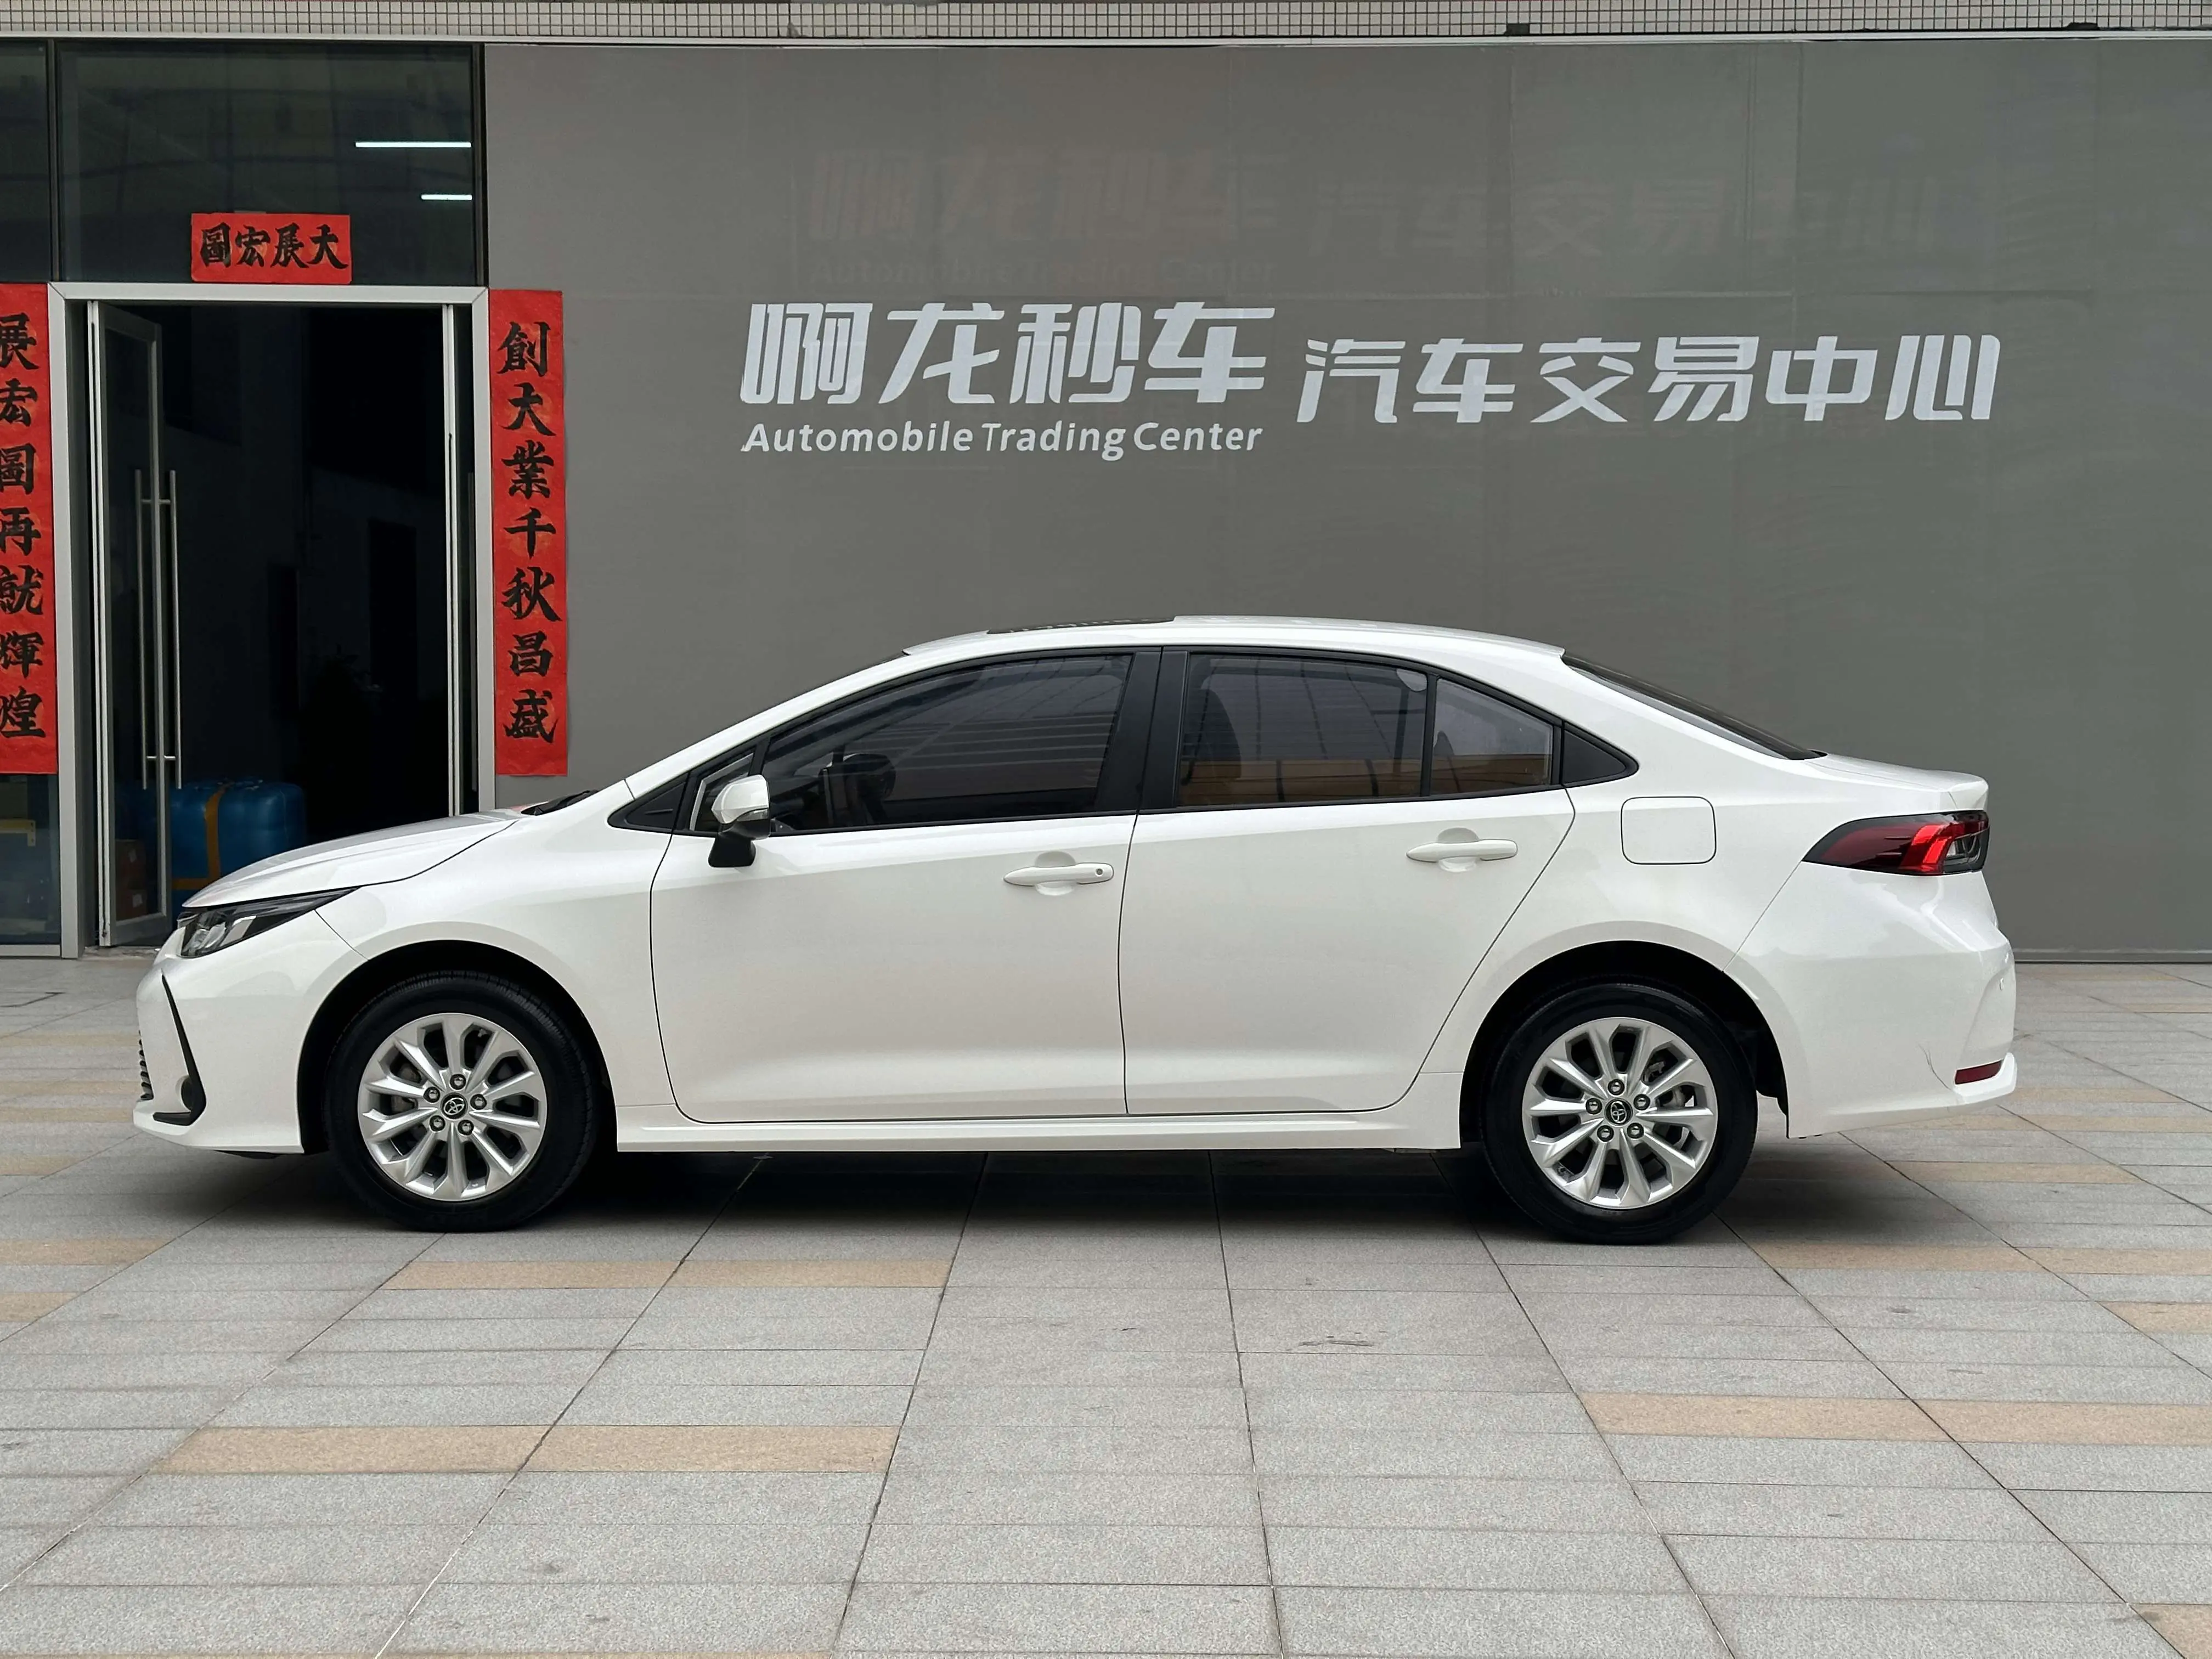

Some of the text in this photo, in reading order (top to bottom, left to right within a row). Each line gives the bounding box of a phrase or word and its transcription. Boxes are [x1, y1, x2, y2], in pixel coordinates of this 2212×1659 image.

[740, 302, 2000, 423] 啊龙秒车 汽车交易中心
[741, 420, 1263, 461] Automobile Trading Center
[498, 322, 561, 743] 創大業千秋昌盛
